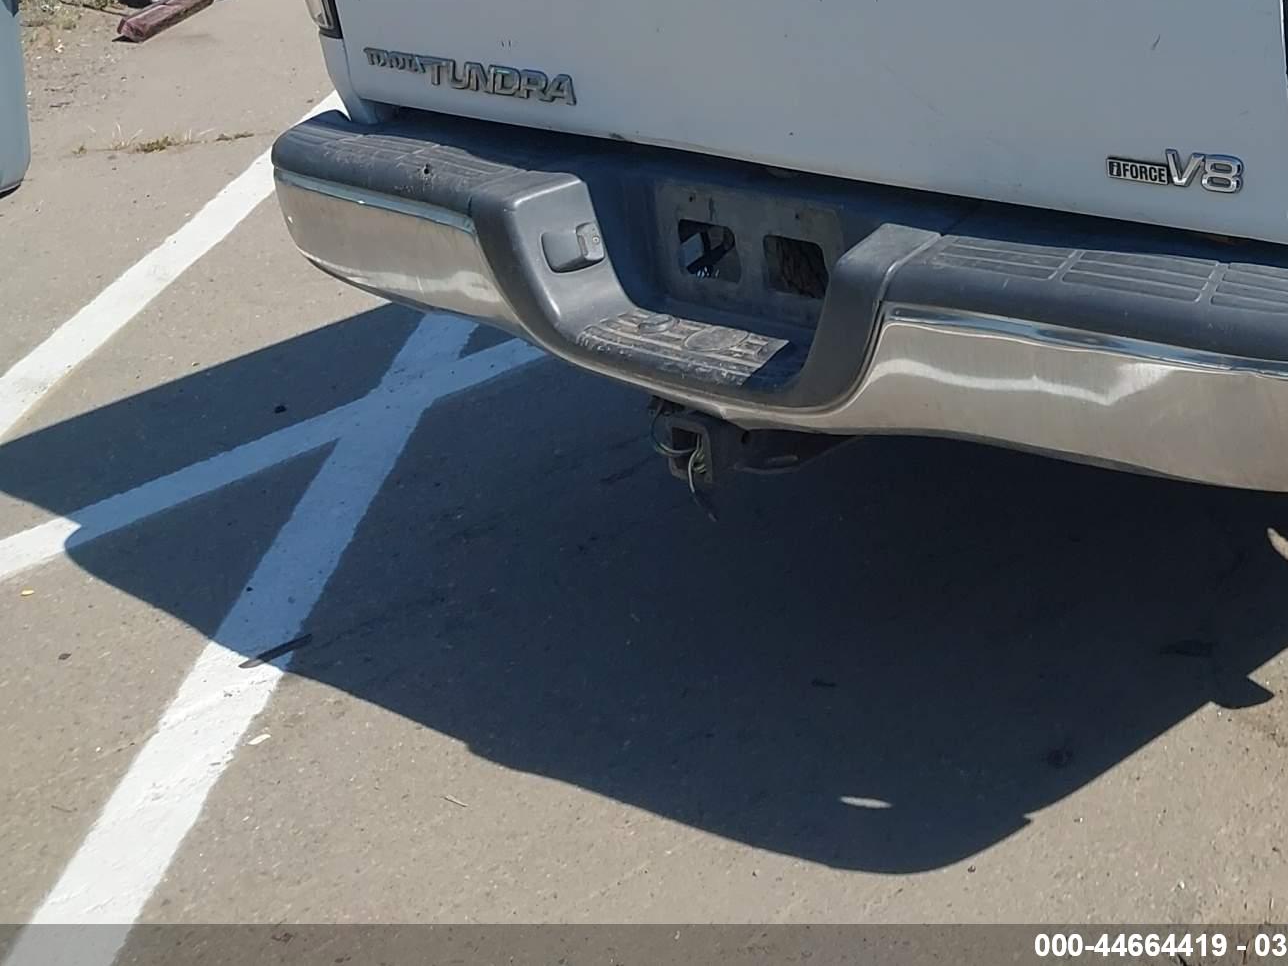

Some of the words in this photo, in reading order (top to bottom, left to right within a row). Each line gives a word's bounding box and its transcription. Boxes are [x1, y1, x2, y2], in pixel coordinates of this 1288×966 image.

[363, 46, 426, 74] TOYOTA
[417, 55, 578, 106] TUNDRA
[1165, 147, 1245, 194] V8
